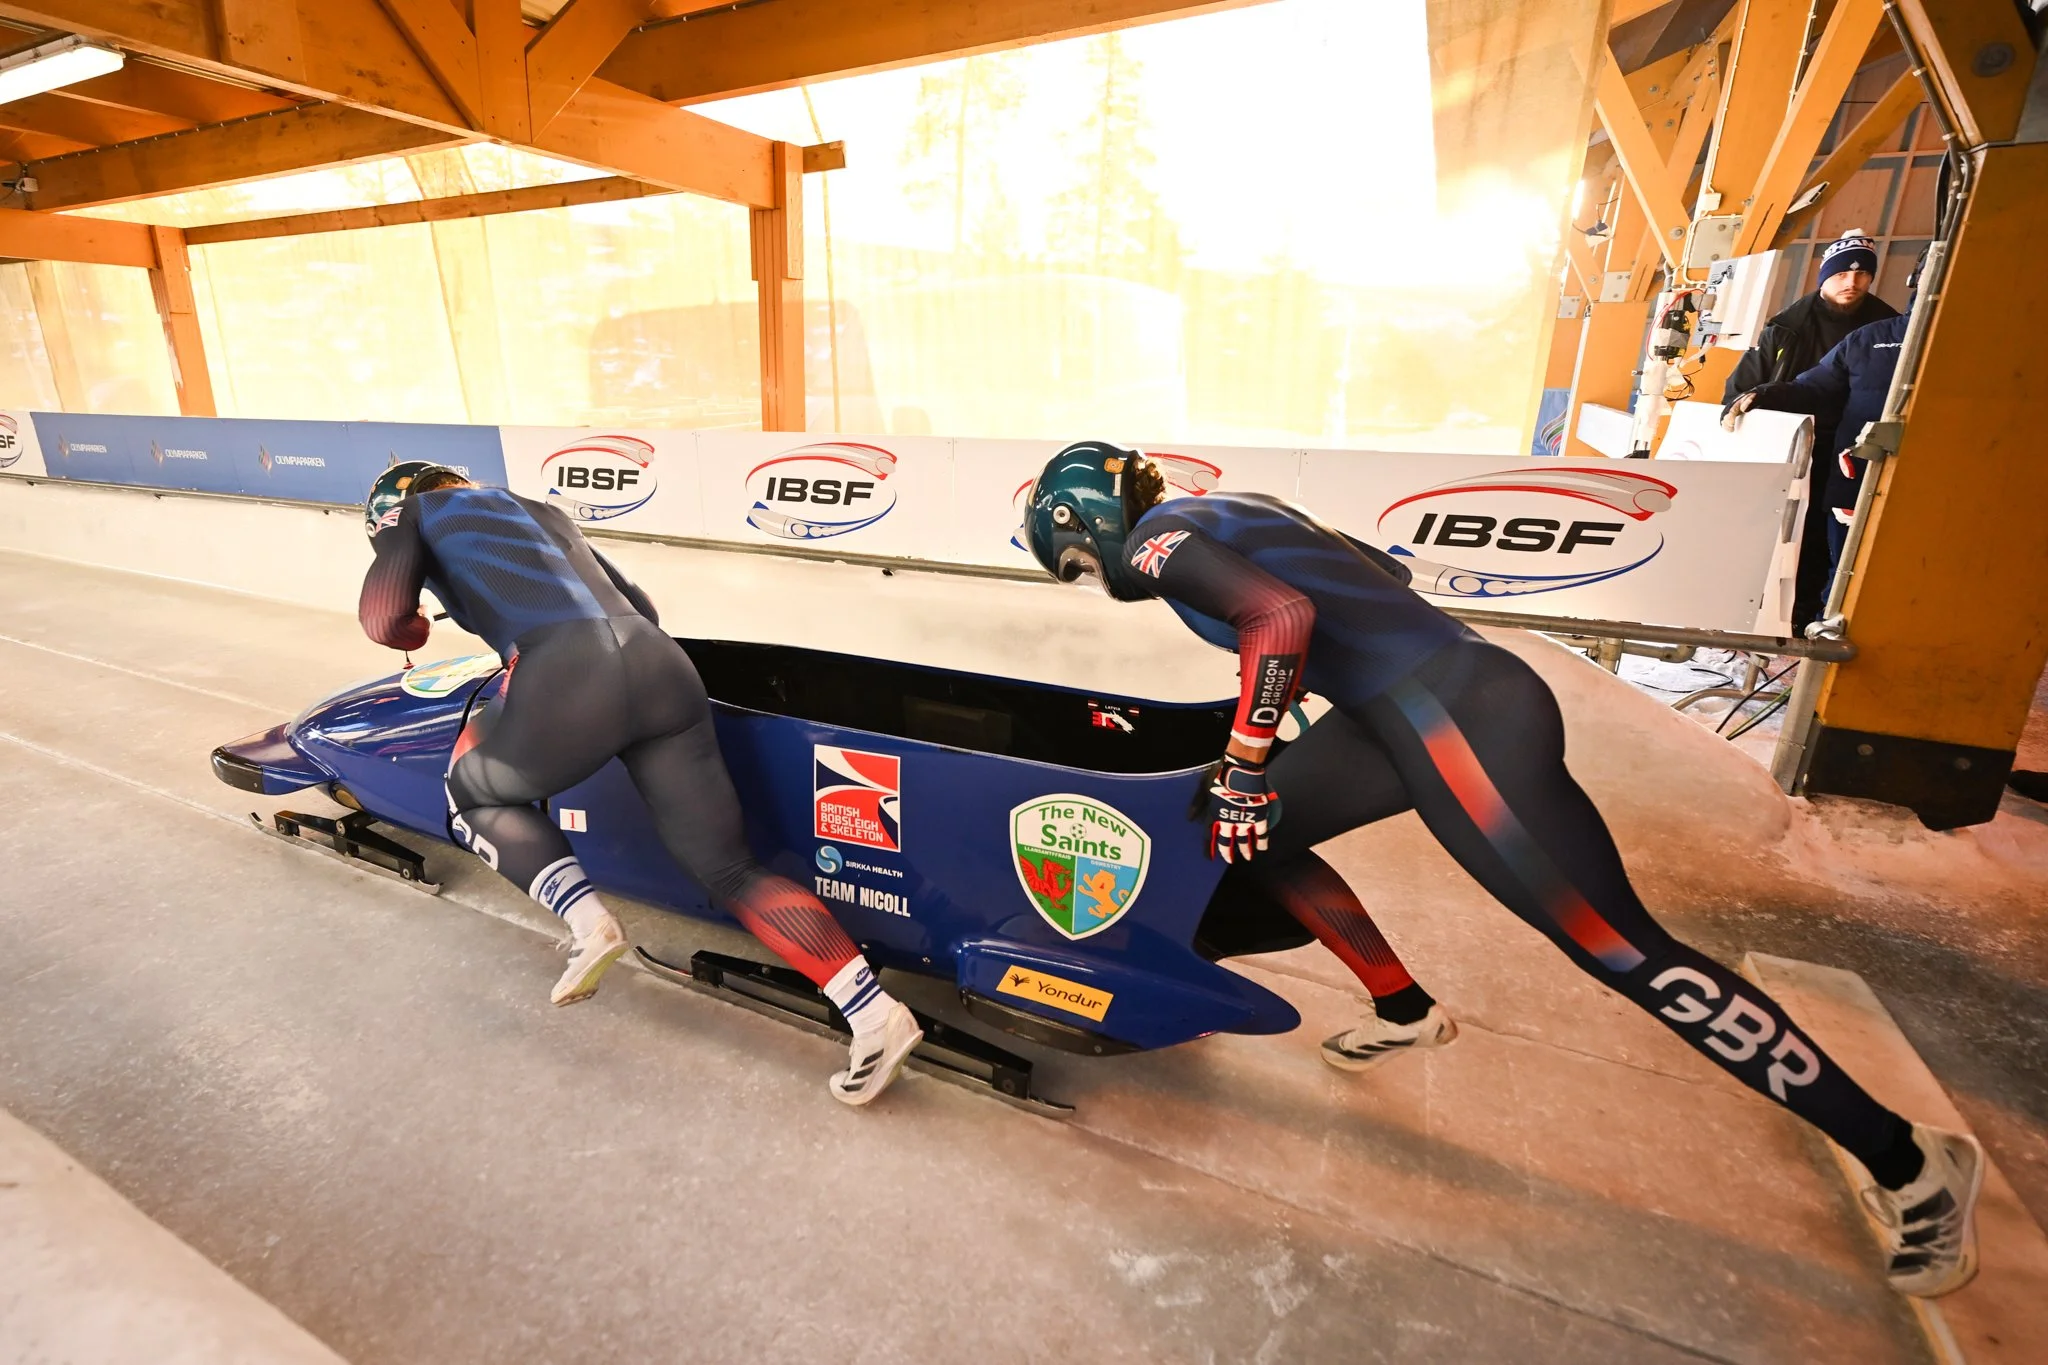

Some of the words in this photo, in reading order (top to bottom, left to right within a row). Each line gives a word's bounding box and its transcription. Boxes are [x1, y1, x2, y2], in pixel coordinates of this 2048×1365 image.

[164, 448, 208, 461] OLYMPIAPARKEN
[274, 455, 326, 468] OLYMPIAPARKEN
[557, 466, 640, 491] IBSF
[765, 476, 875, 506] IBSF
[1411, 512, 1626, 555] IBSF
[1260, 659, 1280, 705] DRAGON
[1270, 668, 1287, 705] GROUP
[568, 812, 577, 830] 1
[820, 801, 861, 818] BRITISH
[820, 812, 879, 832] BOBSLEIGH
[1038, 805, 1075, 821] The
[1082, 807, 1127, 839] New
[820, 823, 829, 834] &
[830, 824, 884, 843] SKELETON
[1040, 823, 1122, 861] Saints
[845, 860, 871, 872] SIRKKA
[872, 866, 903, 879] HEALTH
[814, 876, 856, 904] TEAM
[859, 886, 911, 918] NICOLL
[1037, 980, 1103, 1010] Yondur
[1648, 965, 1821, 1103] GBR
